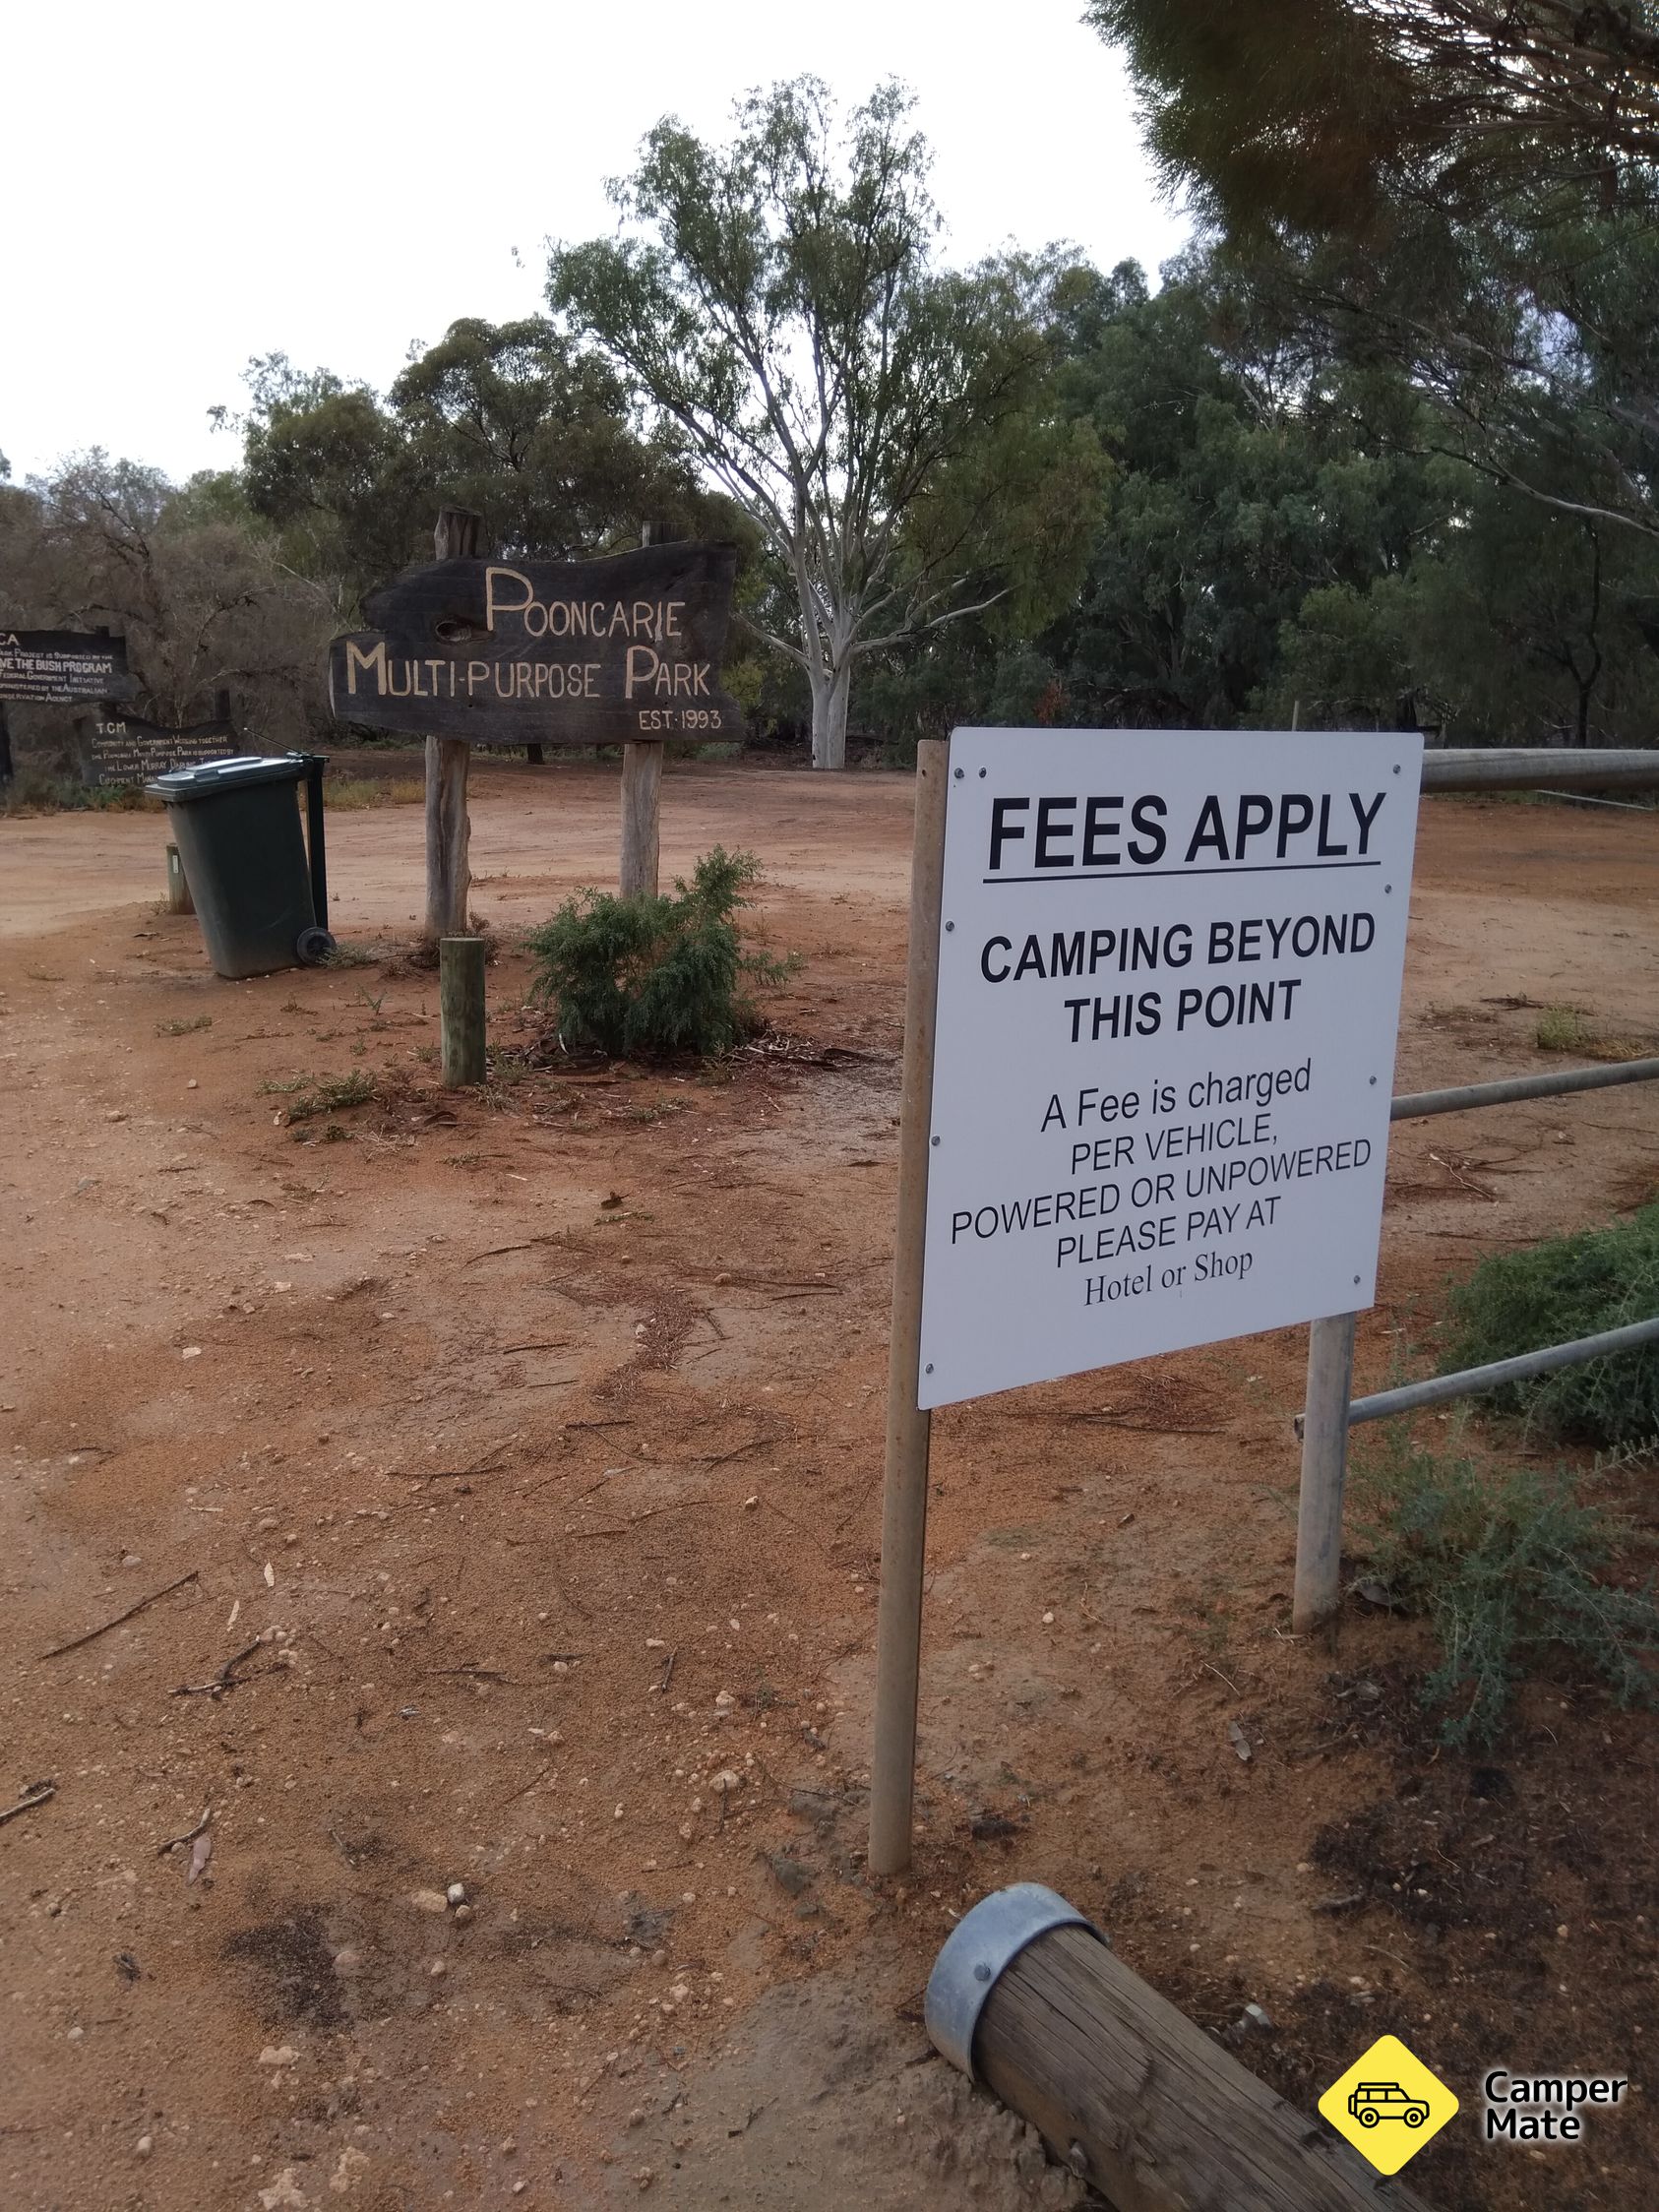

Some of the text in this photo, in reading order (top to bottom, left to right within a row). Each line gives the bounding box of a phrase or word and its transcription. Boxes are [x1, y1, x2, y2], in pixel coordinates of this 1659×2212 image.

[485, 566, 686, 643] POONCARIE
[15, 657, 35, 671] THE
[35, 659, 61, 672] BUSH
[62, 660, 113, 674] PROGRAM
[27, 670, 67, 683] GOVERNMENT
[69, 673, 104, 685] INITIATIVE
[63, 683, 108, 695] AUSTRALIAN
[345, 641, 710, 700] MULTI-PURPOSE PARK
[137, 735, 173, 748] GOVERNMENT
[199, 735, 228, 744] TOGETHER
[141, 759, 167, 771] MURRAY
[988, 792, 1387, 871] FEES APPLY
[980, 911, 1377, 984] CAMPING BEYOND
[1064, 978, 1302, 1043] THIS POINT
[1040, 1058, 1313, 1133] A Fee is charged
[1072, 1112, 1279, 1175] PER VEHICLE,
[952, 1137, 1372, 1245] POWERED OR UNPOWERED
[1057, 1196, 1281, 1268] PLEASE PAY AT
[1083, 1251, 1254, 1307] Hotel or Shop
